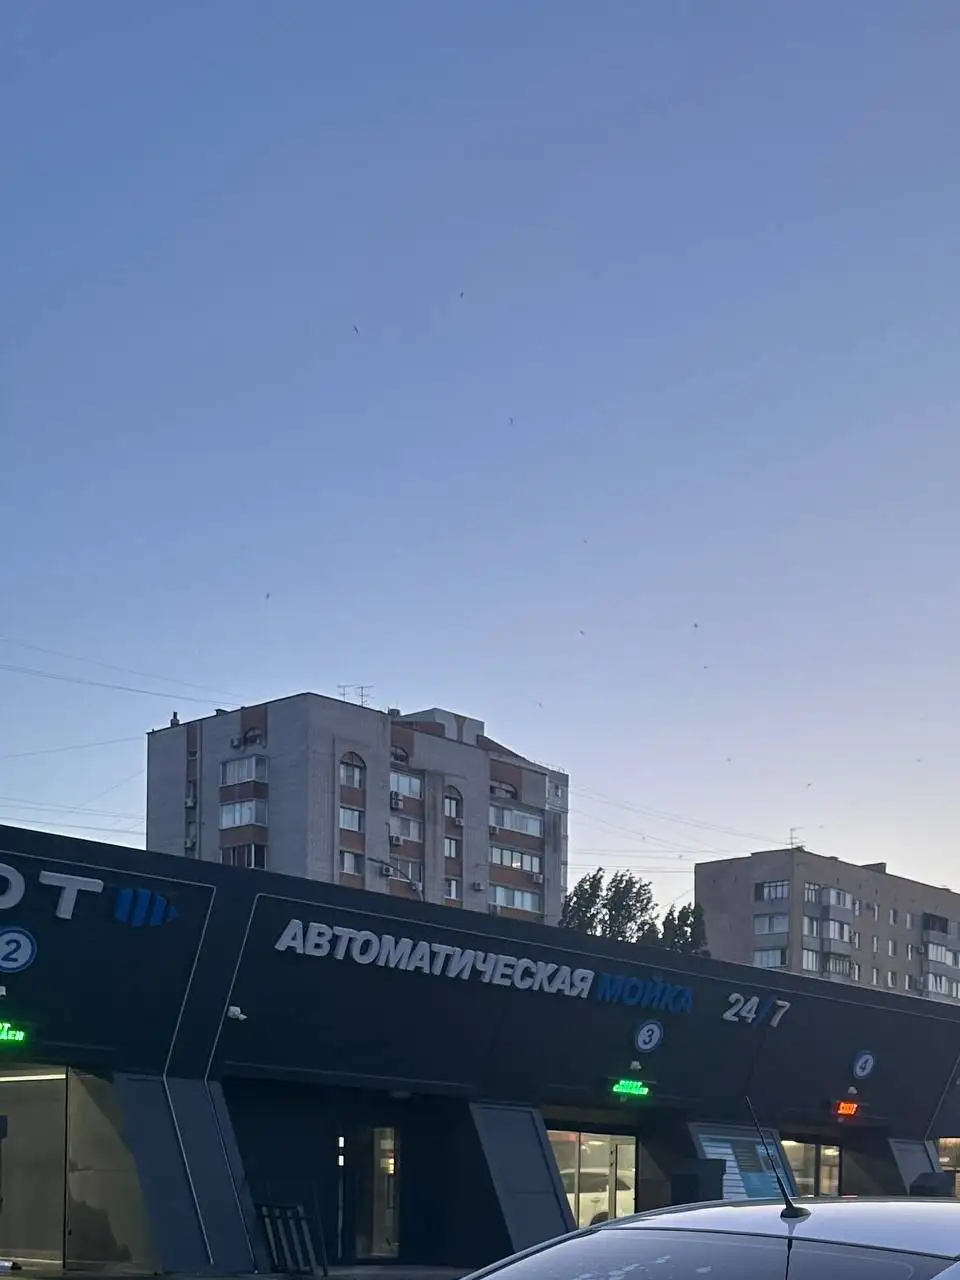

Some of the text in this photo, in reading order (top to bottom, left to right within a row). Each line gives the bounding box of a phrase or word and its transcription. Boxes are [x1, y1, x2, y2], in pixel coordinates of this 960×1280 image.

[1, 938, 22, 963] 2
[274, 919, 791, 1028] АВТОМАТИЧЕСКАЯ МОЙКА 24/7
[642, 1027, 656, 1046] 3
